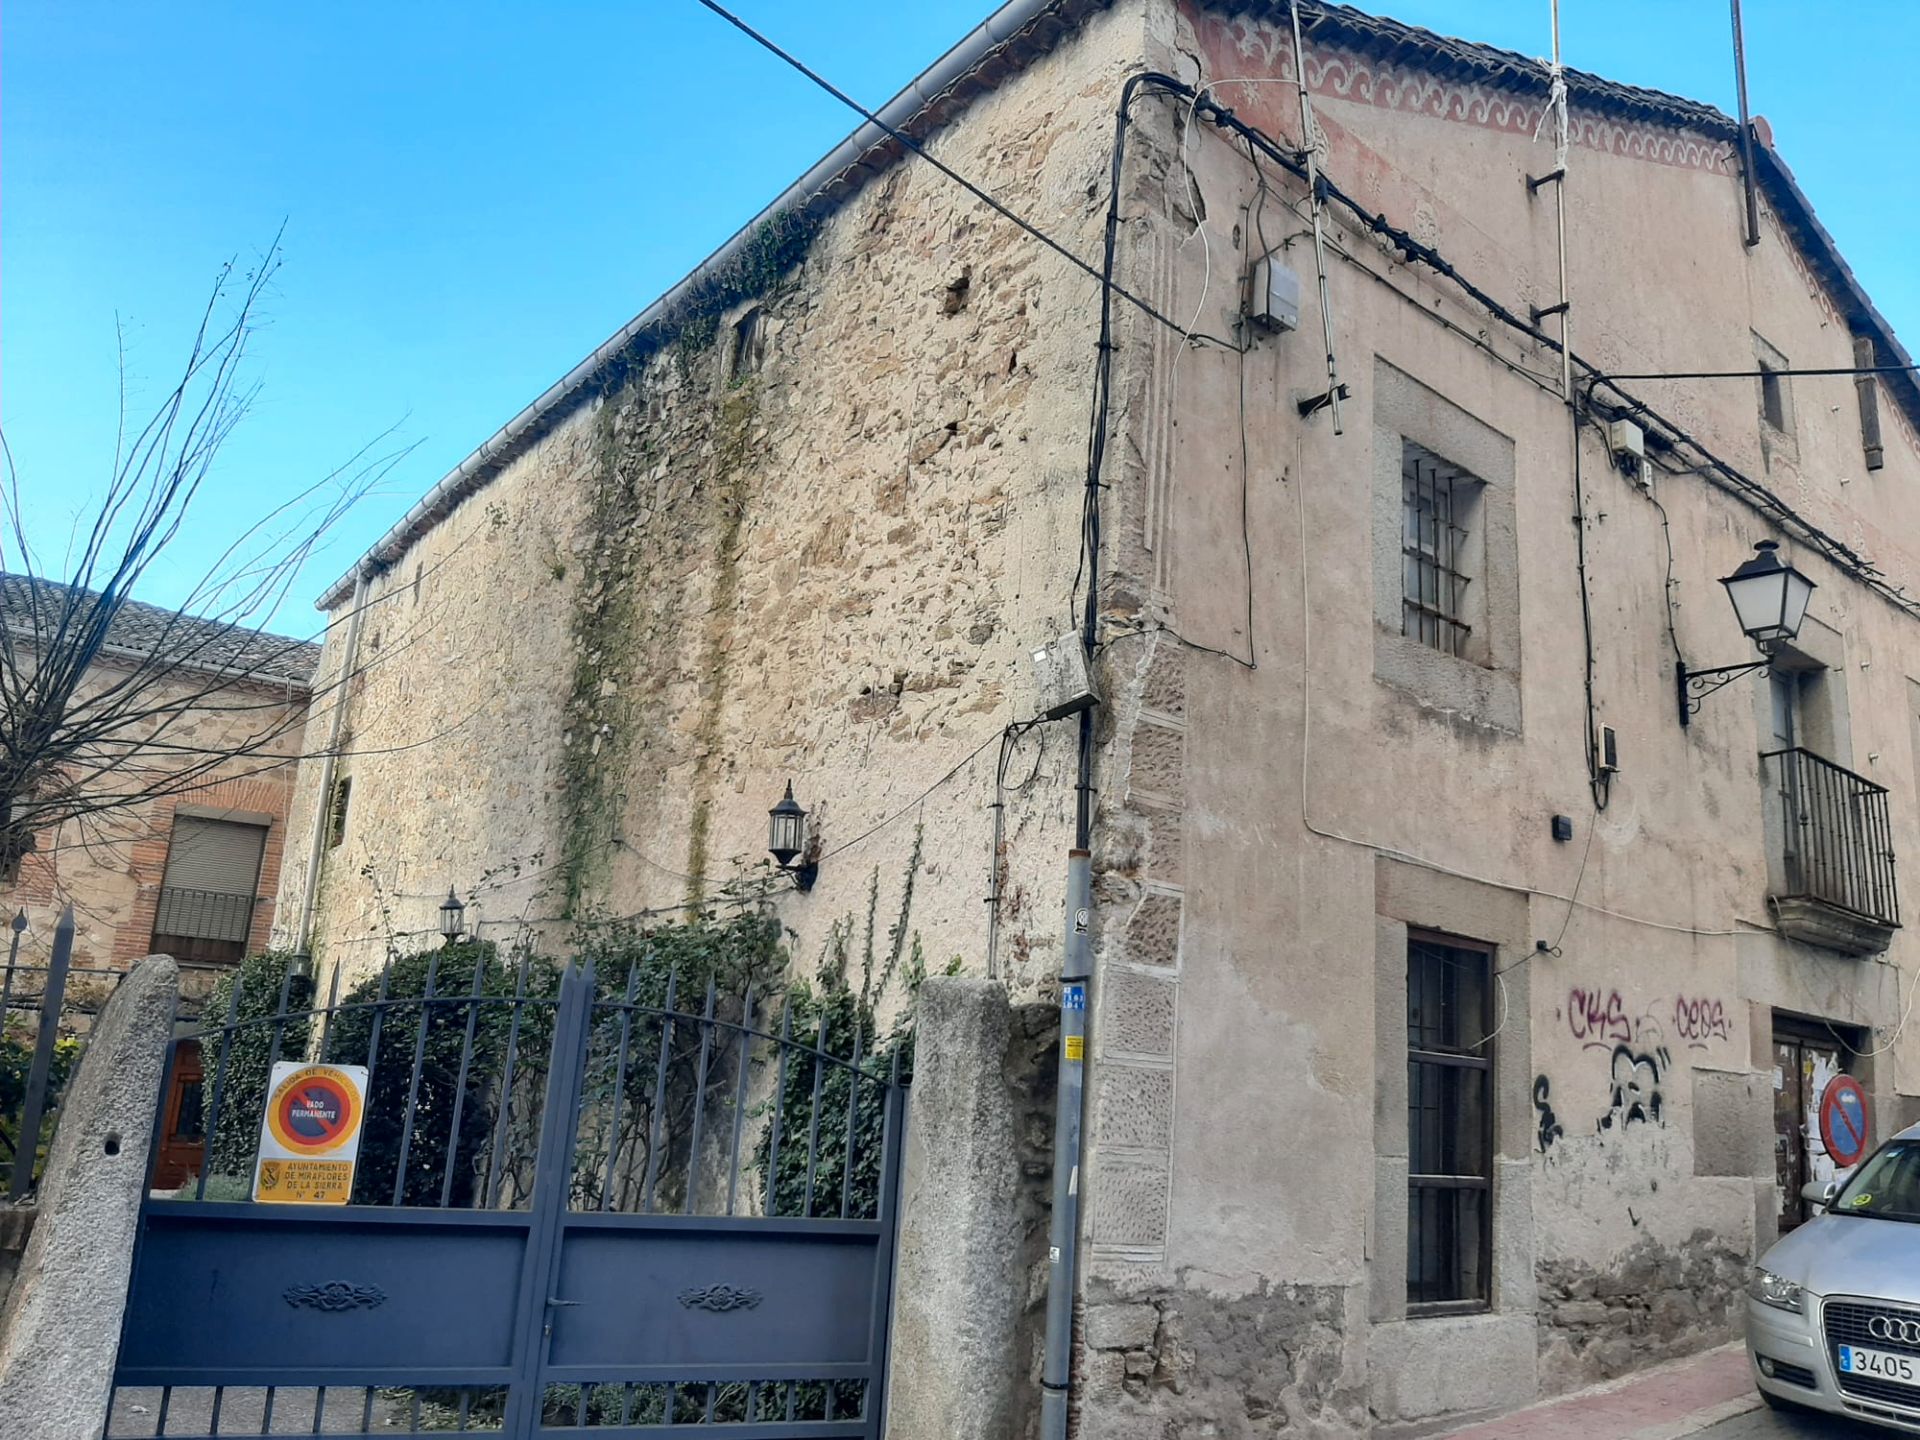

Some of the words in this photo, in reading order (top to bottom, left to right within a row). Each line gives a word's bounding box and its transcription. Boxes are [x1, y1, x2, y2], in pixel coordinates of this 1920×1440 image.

[274, 1073, 301, 1099] SALIDA
[305, 1068, 316, 1077] DE
[306, 1100, 325, 1109] VADO
[291, 1109, 337, 1120] PERMANENTE
[287, 1161, 349, 1171] AYUNTAMIENTO
[284, 1171, 296, 1180] DE
[299, 1171, 348, 1181] MIRAFLORES
[287, 1180, 298, 1189] DE
[301, 1180, 311, 1189] LA
[313, 1181, 343, 1190] SIERRA
[313, 1190, 325, 1199] 47
[1854, 1351, 1913, 1380] 3405
